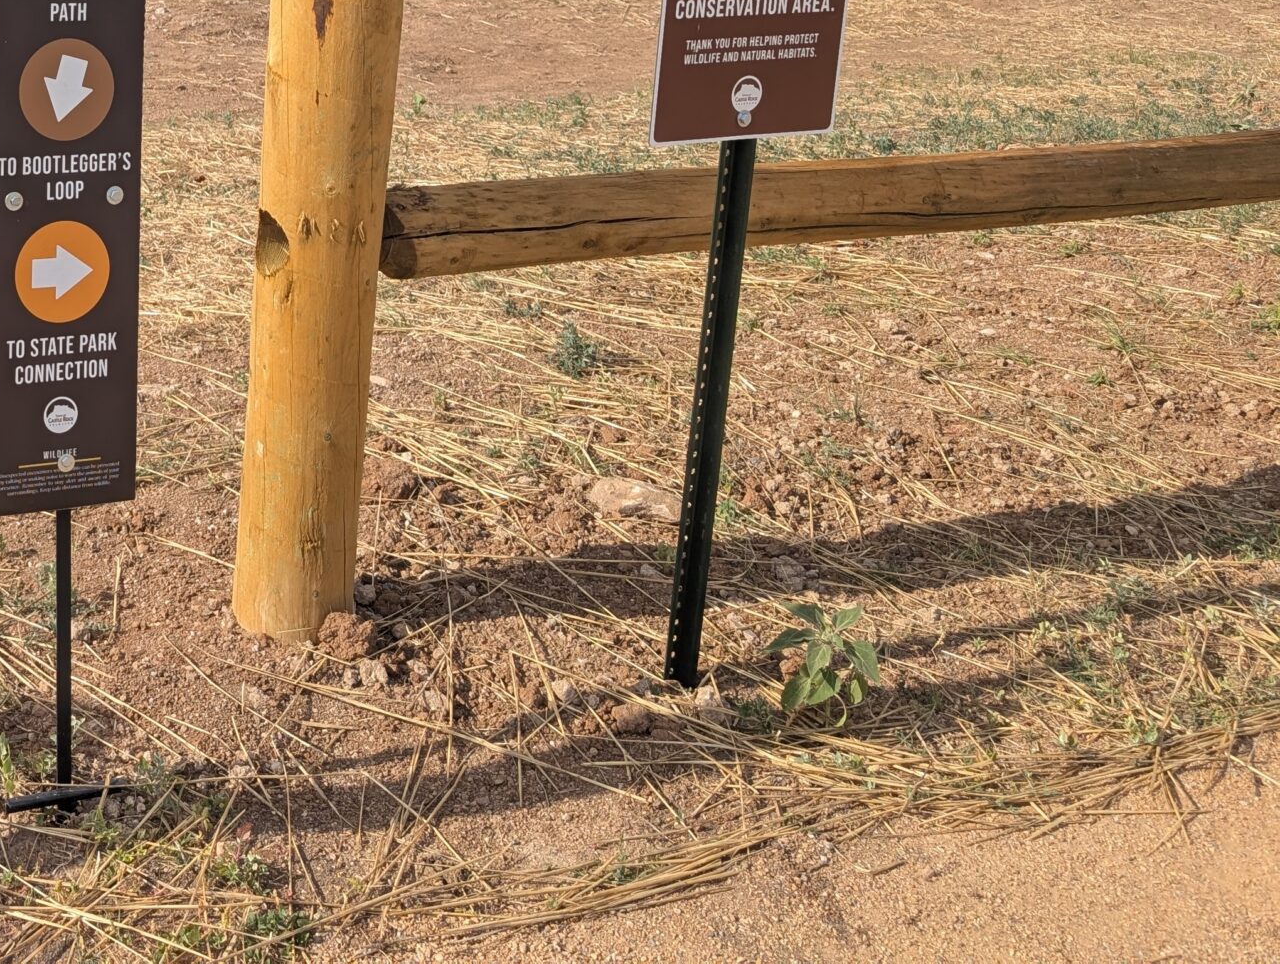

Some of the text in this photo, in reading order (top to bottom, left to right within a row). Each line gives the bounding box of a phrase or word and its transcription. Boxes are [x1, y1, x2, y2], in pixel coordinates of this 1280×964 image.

[50, 3, 87, 22] PATH
[686, 33, 819, 52] THANK YOU FOR HELPING PROTECT
[684, 48, 817, 65] WILDLIFE AND NATURAL HABITATS.
[22, 152, 131, 175] BOOTLEGGER'S
[47, 181, 84, 201] LOOP
[7, 332, 117, 359] TO STATE PARK
[15, 358, 108, 385] CONNECTION
